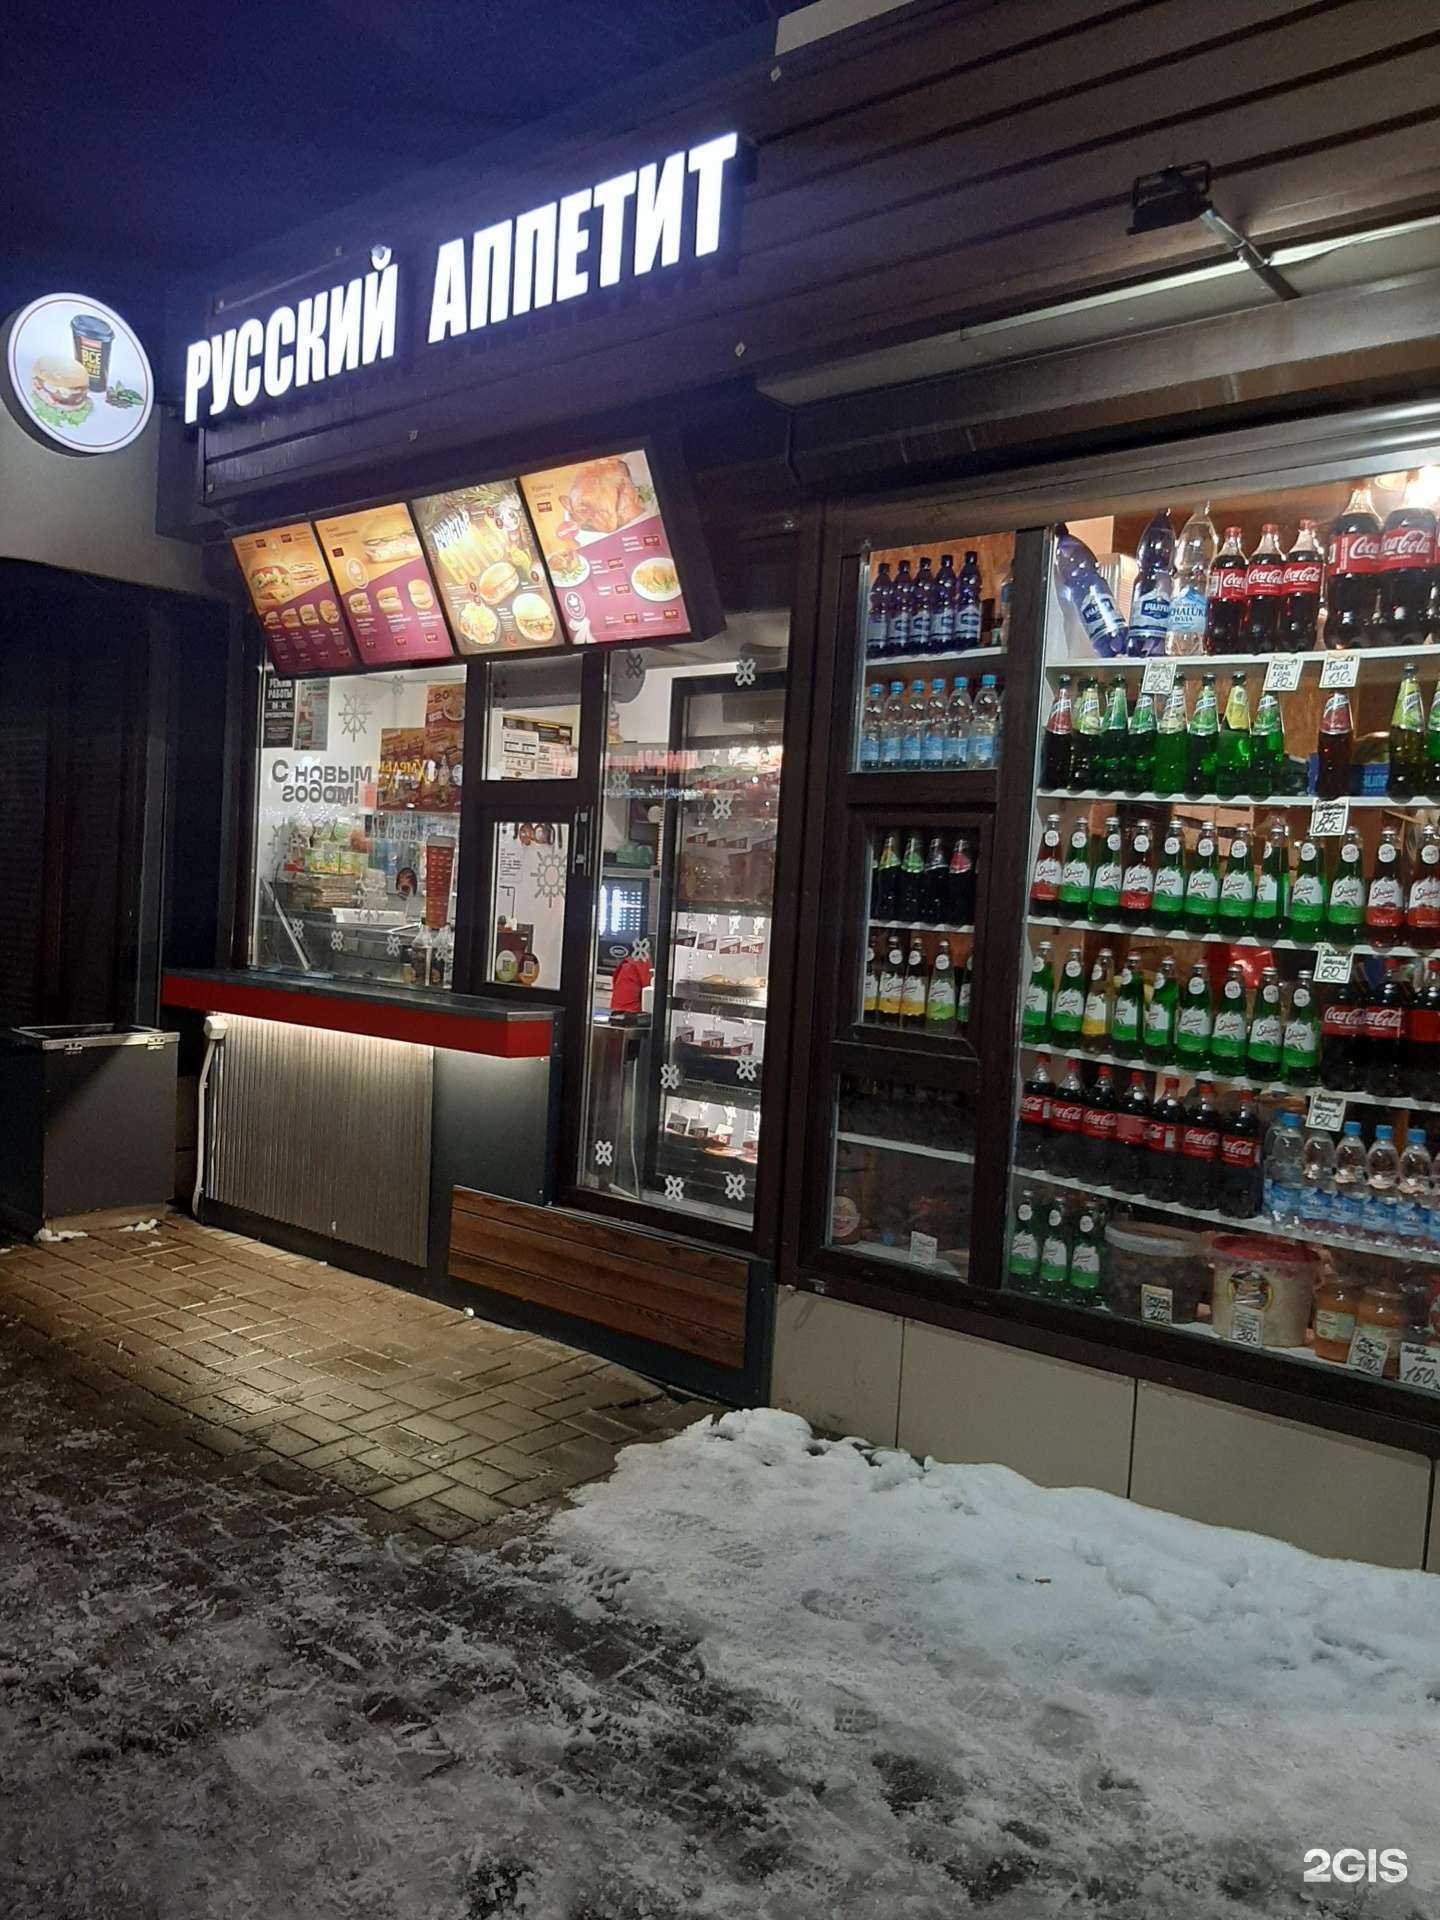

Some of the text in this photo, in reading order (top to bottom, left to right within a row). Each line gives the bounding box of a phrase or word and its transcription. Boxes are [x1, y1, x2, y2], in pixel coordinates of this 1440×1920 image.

[184, 131, 739, 425] РУССКИЙ АППЕТИТ
[272, 759, 289, 783] С
